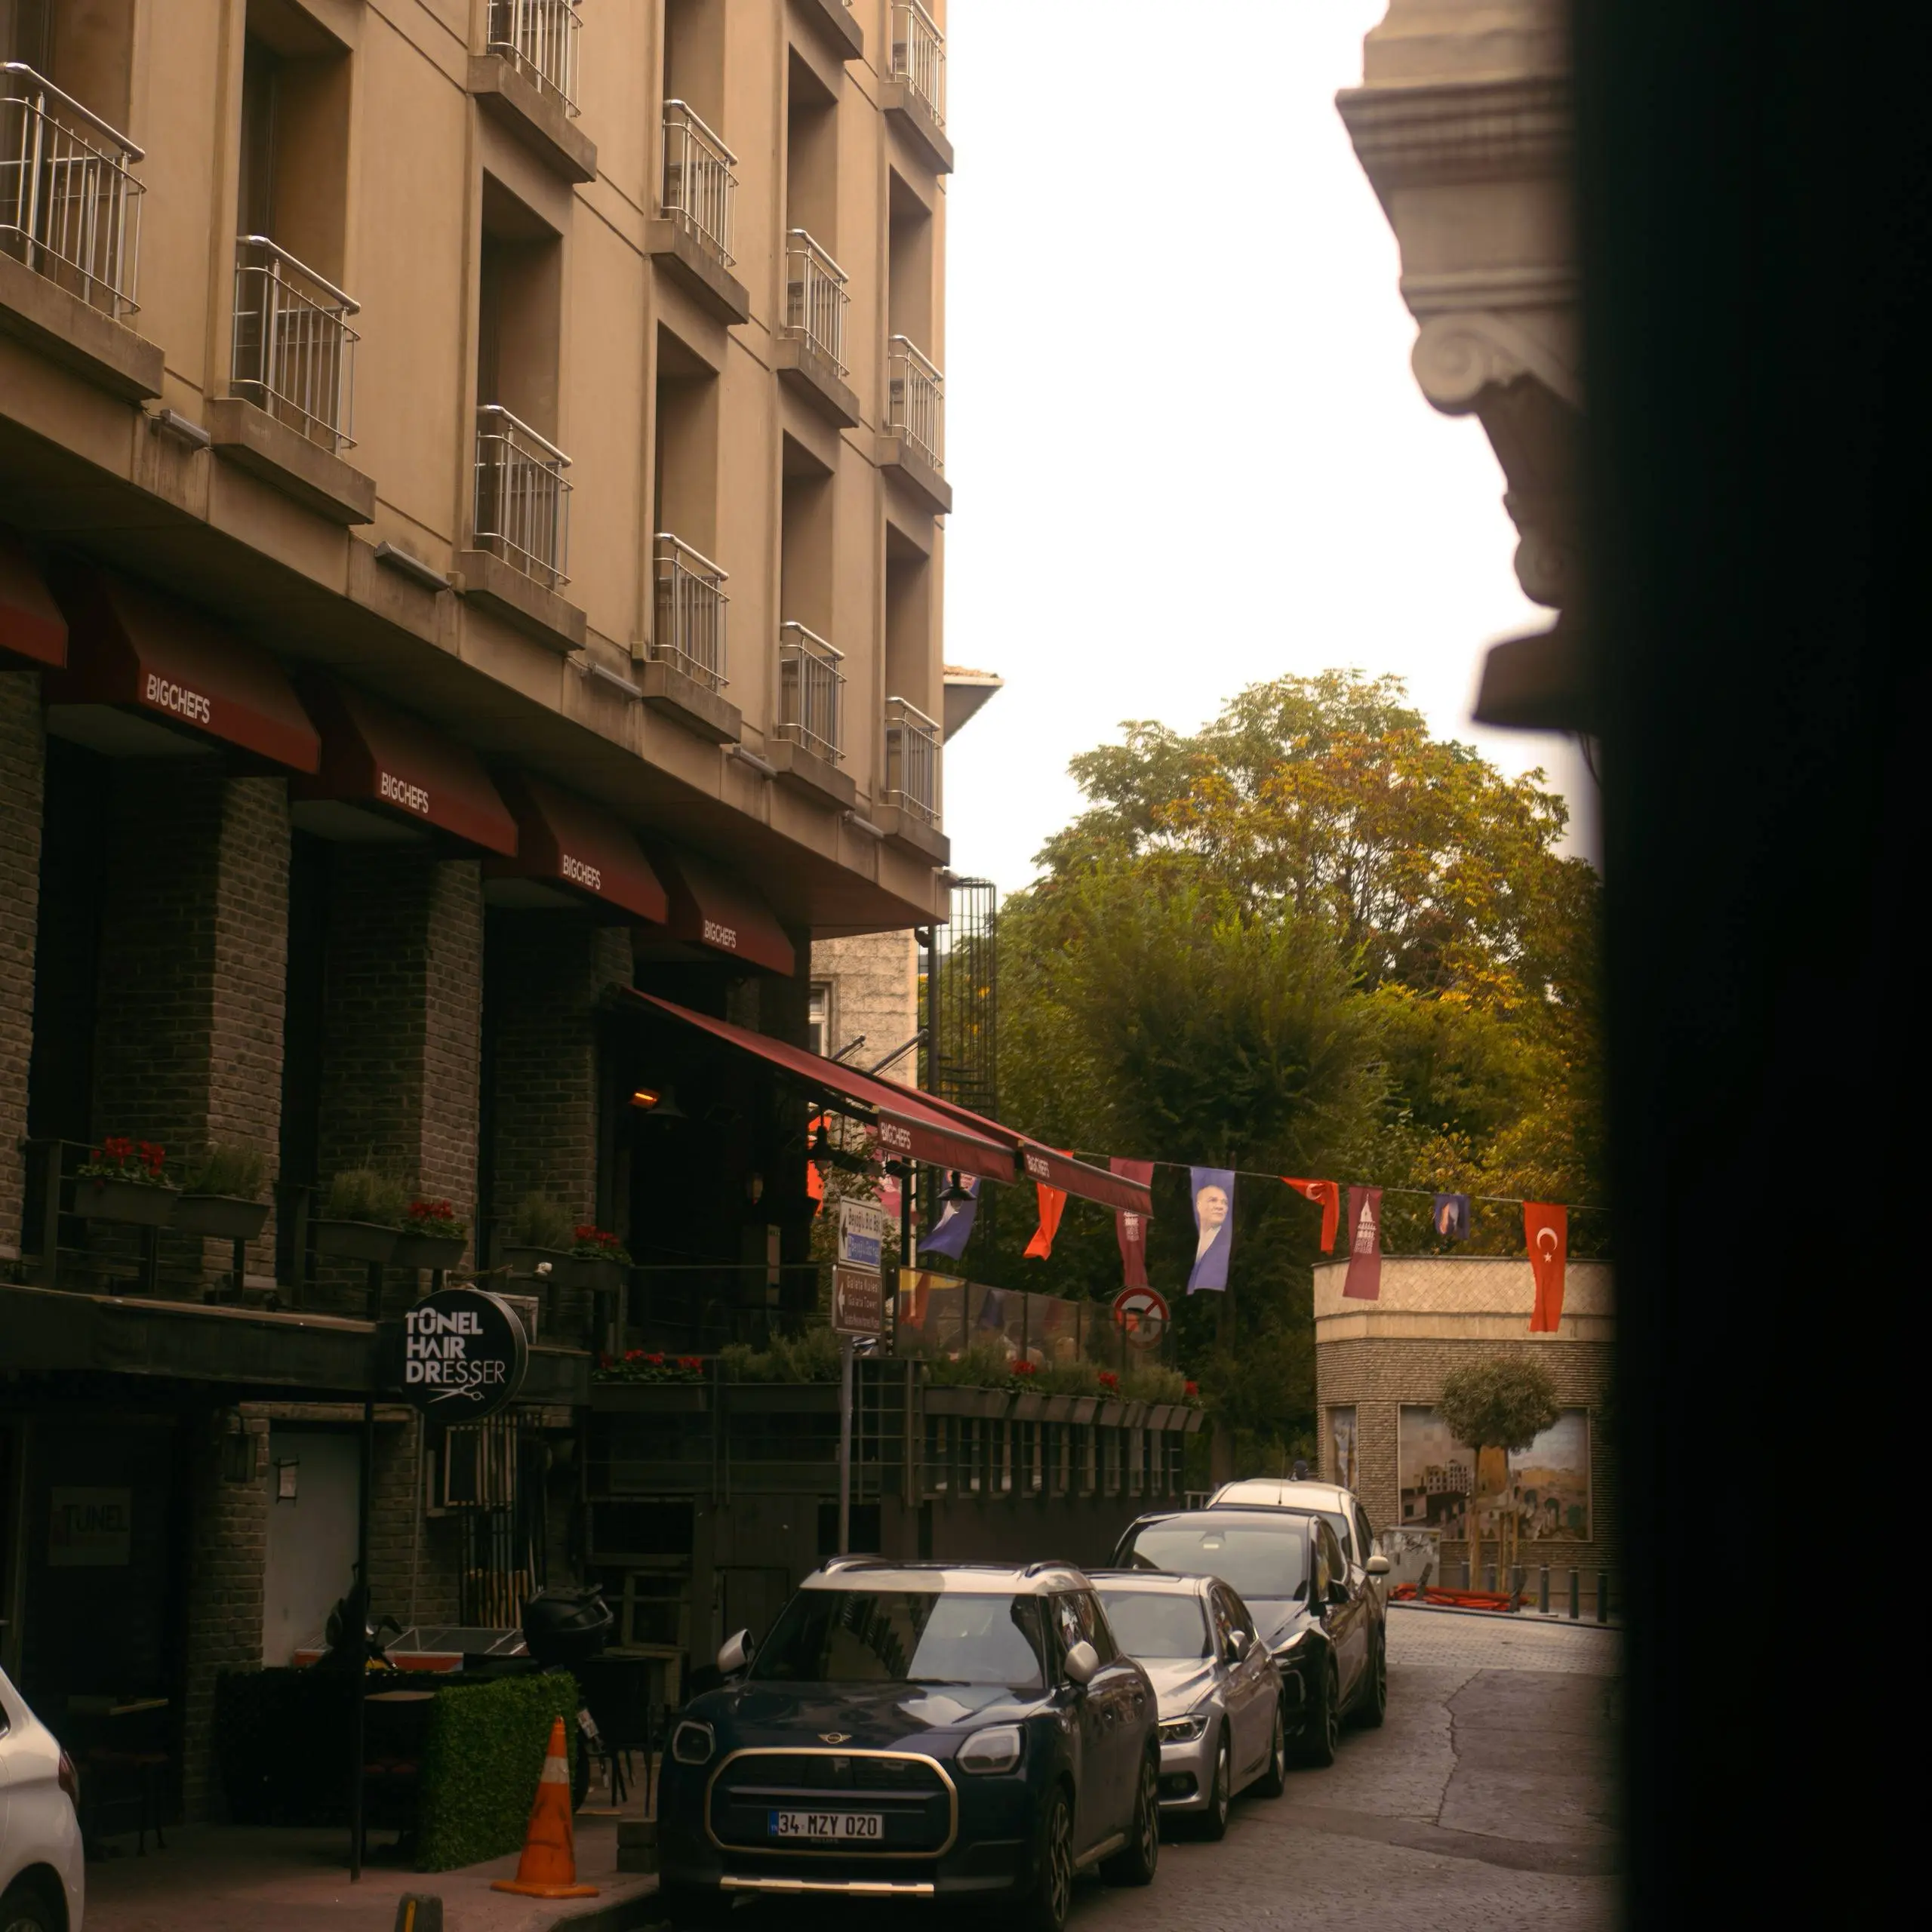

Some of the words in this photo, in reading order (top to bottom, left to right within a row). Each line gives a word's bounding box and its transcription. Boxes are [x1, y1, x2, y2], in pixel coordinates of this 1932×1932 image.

[147, 674, 211, 724] BIGCHEFS
[381, 771, 429, 814] BIGCHEFS
[563, 854, 601, 890] BIGCHEFS
[704, 920, 737, 949] BIGCHEFS
[881, 1122, 911, 1149] BIGCHEFS
[408, 1337, 466, 1358] HAIR
[406, 1361, 505, 1384] DRESSER
[780, 1814, 799, 1834] 34
[808, 1815, 838, 1835] MZY
[846, 1817, 877, 1836] 020
